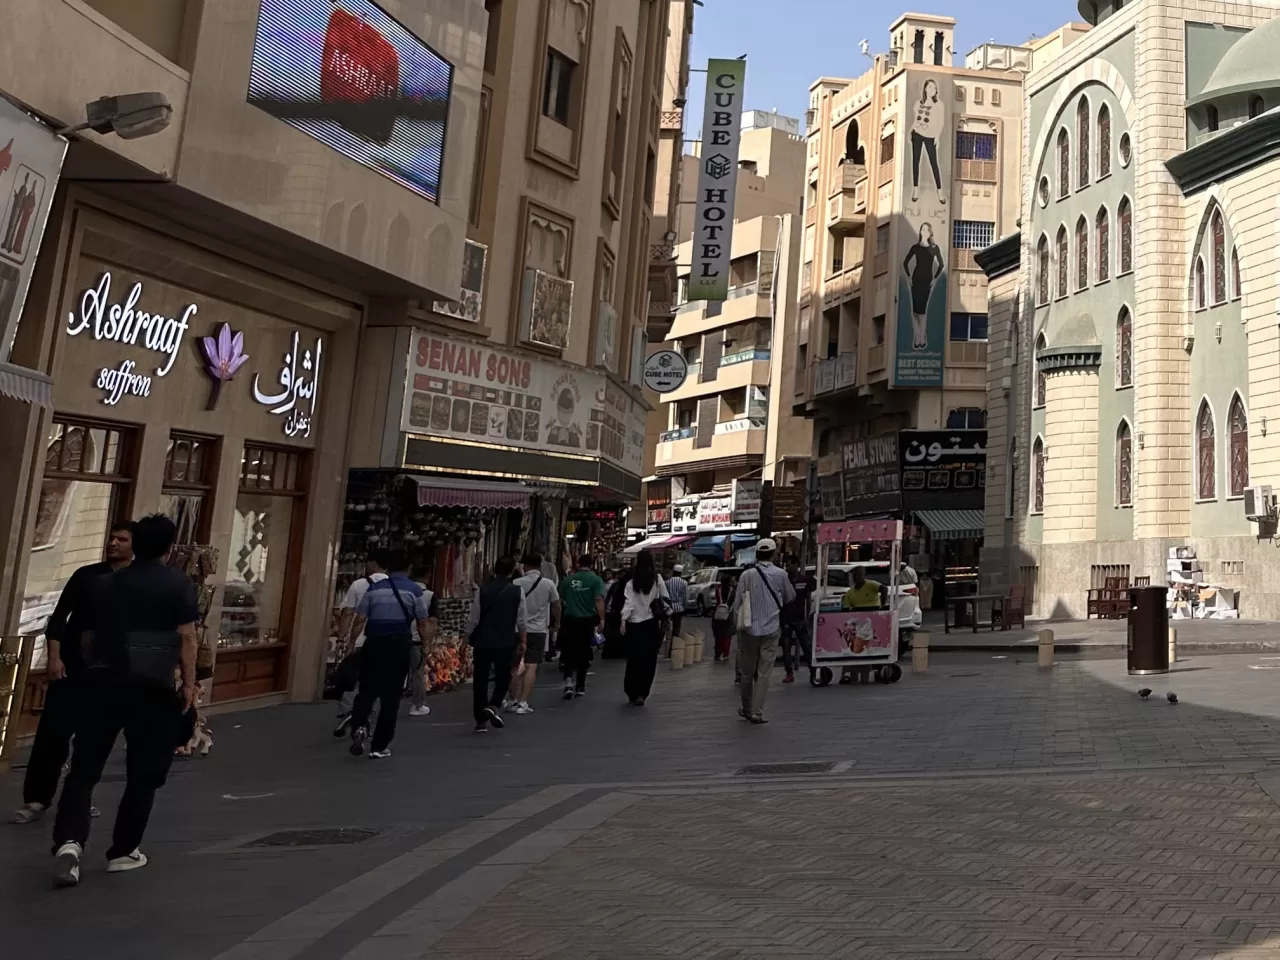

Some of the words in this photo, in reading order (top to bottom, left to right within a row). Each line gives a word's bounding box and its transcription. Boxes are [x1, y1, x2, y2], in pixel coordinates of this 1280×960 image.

[709, 73, 736, 146] CUBE
[699, 188, 728, 278] HOTEL
[67, 272, 198, 377] Ashraaf
[97, 359, 151, 405] saffron
[254, 330, 322, 415] اشراف
[416, 337, 482, 378] SENAN
[486, 352, 531, 389] SONS
[284, 409, 311, 438] زعفران
[843, 440, 869, 469] PEARL
[869, 436, 897, 465] STONE
